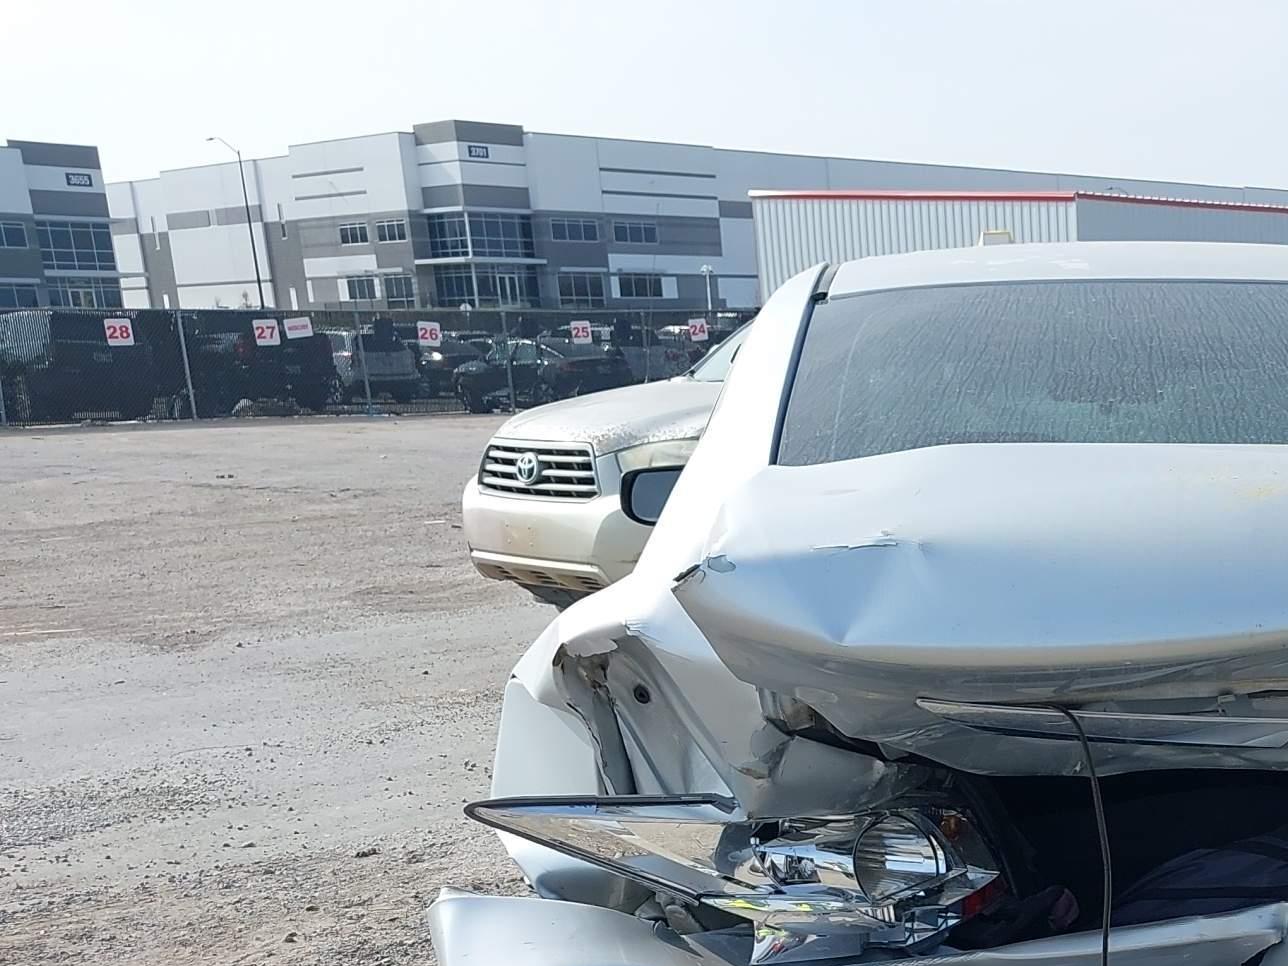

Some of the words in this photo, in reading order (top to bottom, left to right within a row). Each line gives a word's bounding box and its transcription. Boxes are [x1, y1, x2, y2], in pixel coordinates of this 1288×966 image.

[106, 324, 131, 339] 28
[255, 325, 276, 339] 27
[419, 327, 438, 341] 26
[572, 326, 590, 338] 25
[690, 323, 706, 336] 24
